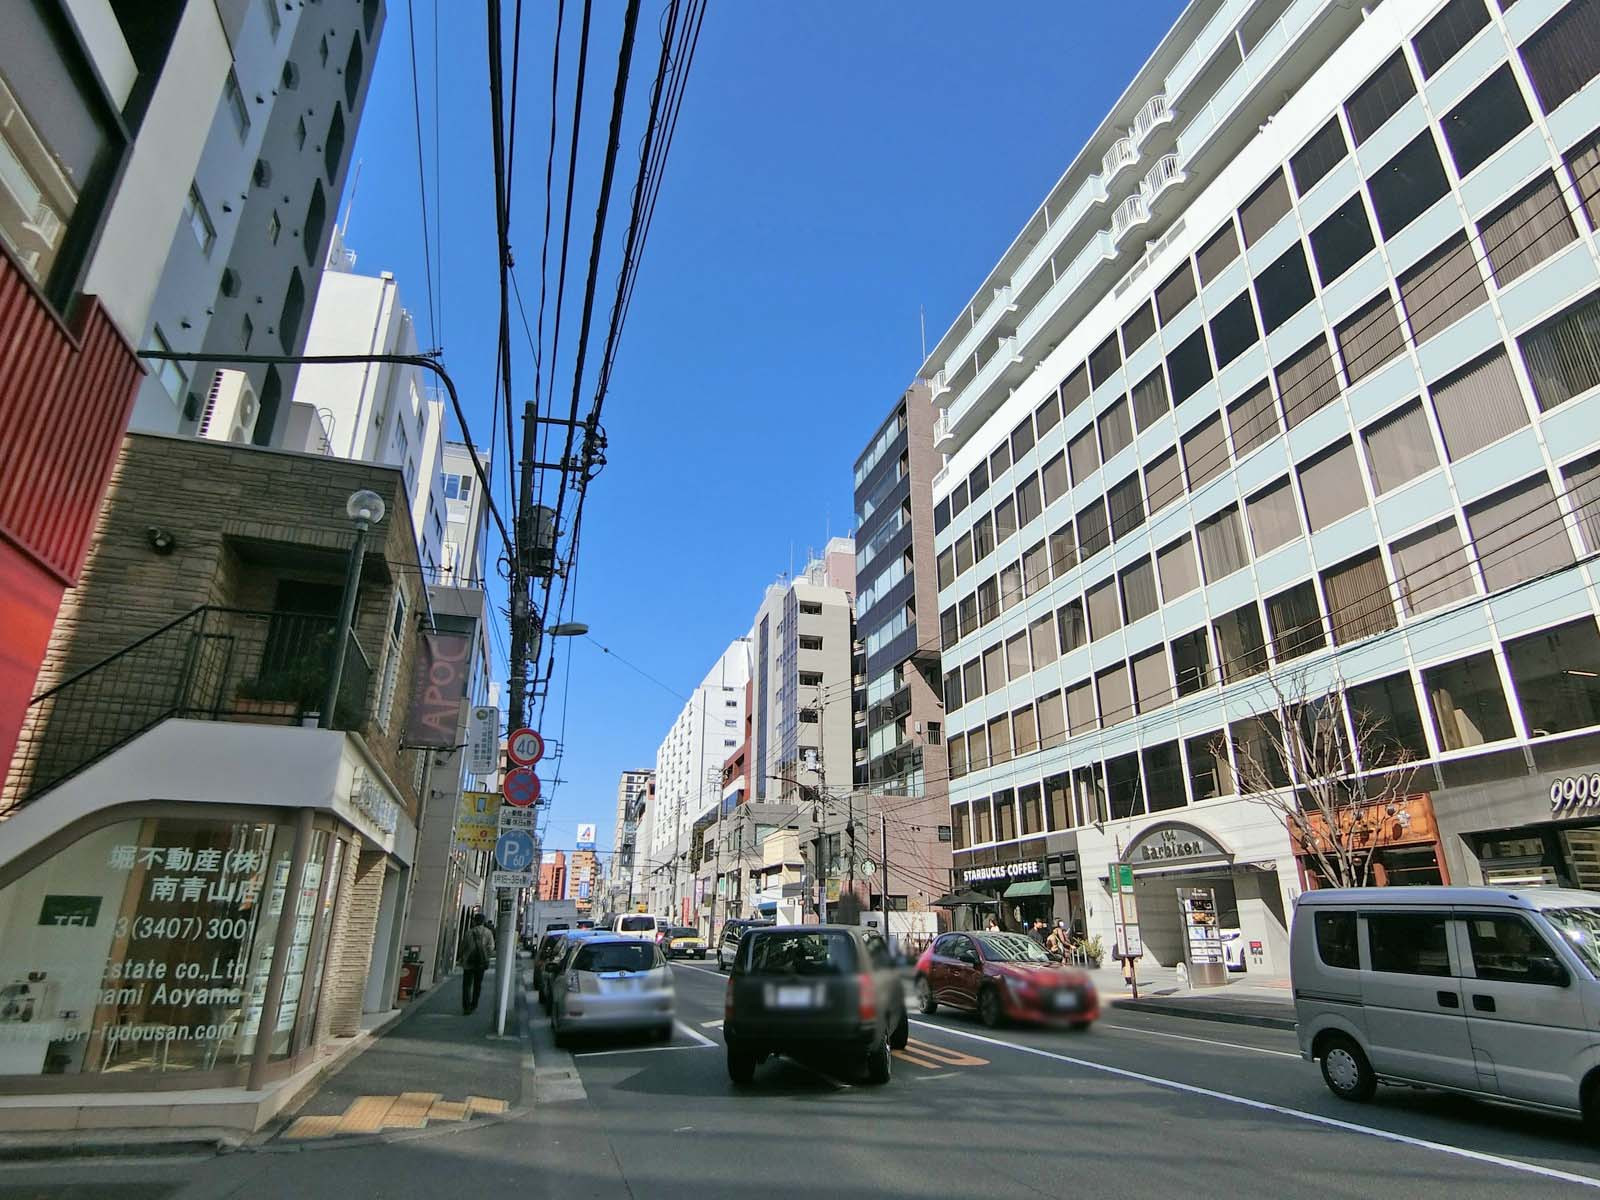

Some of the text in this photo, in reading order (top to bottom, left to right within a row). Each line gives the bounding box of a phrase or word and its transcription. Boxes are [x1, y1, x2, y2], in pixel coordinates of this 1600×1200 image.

[517, 739, 537, 756] 40
[503, 841, 519, 866] P
[513, 855, 525, 867] 60
[963, 861, 1038, 882] STARBUCKS COFFEE
[150, 875, 262, 904] 南青山店
[115, 915, 256, 941] 3(3407)3001
[152, 983, 241, 1007] Aoyama
